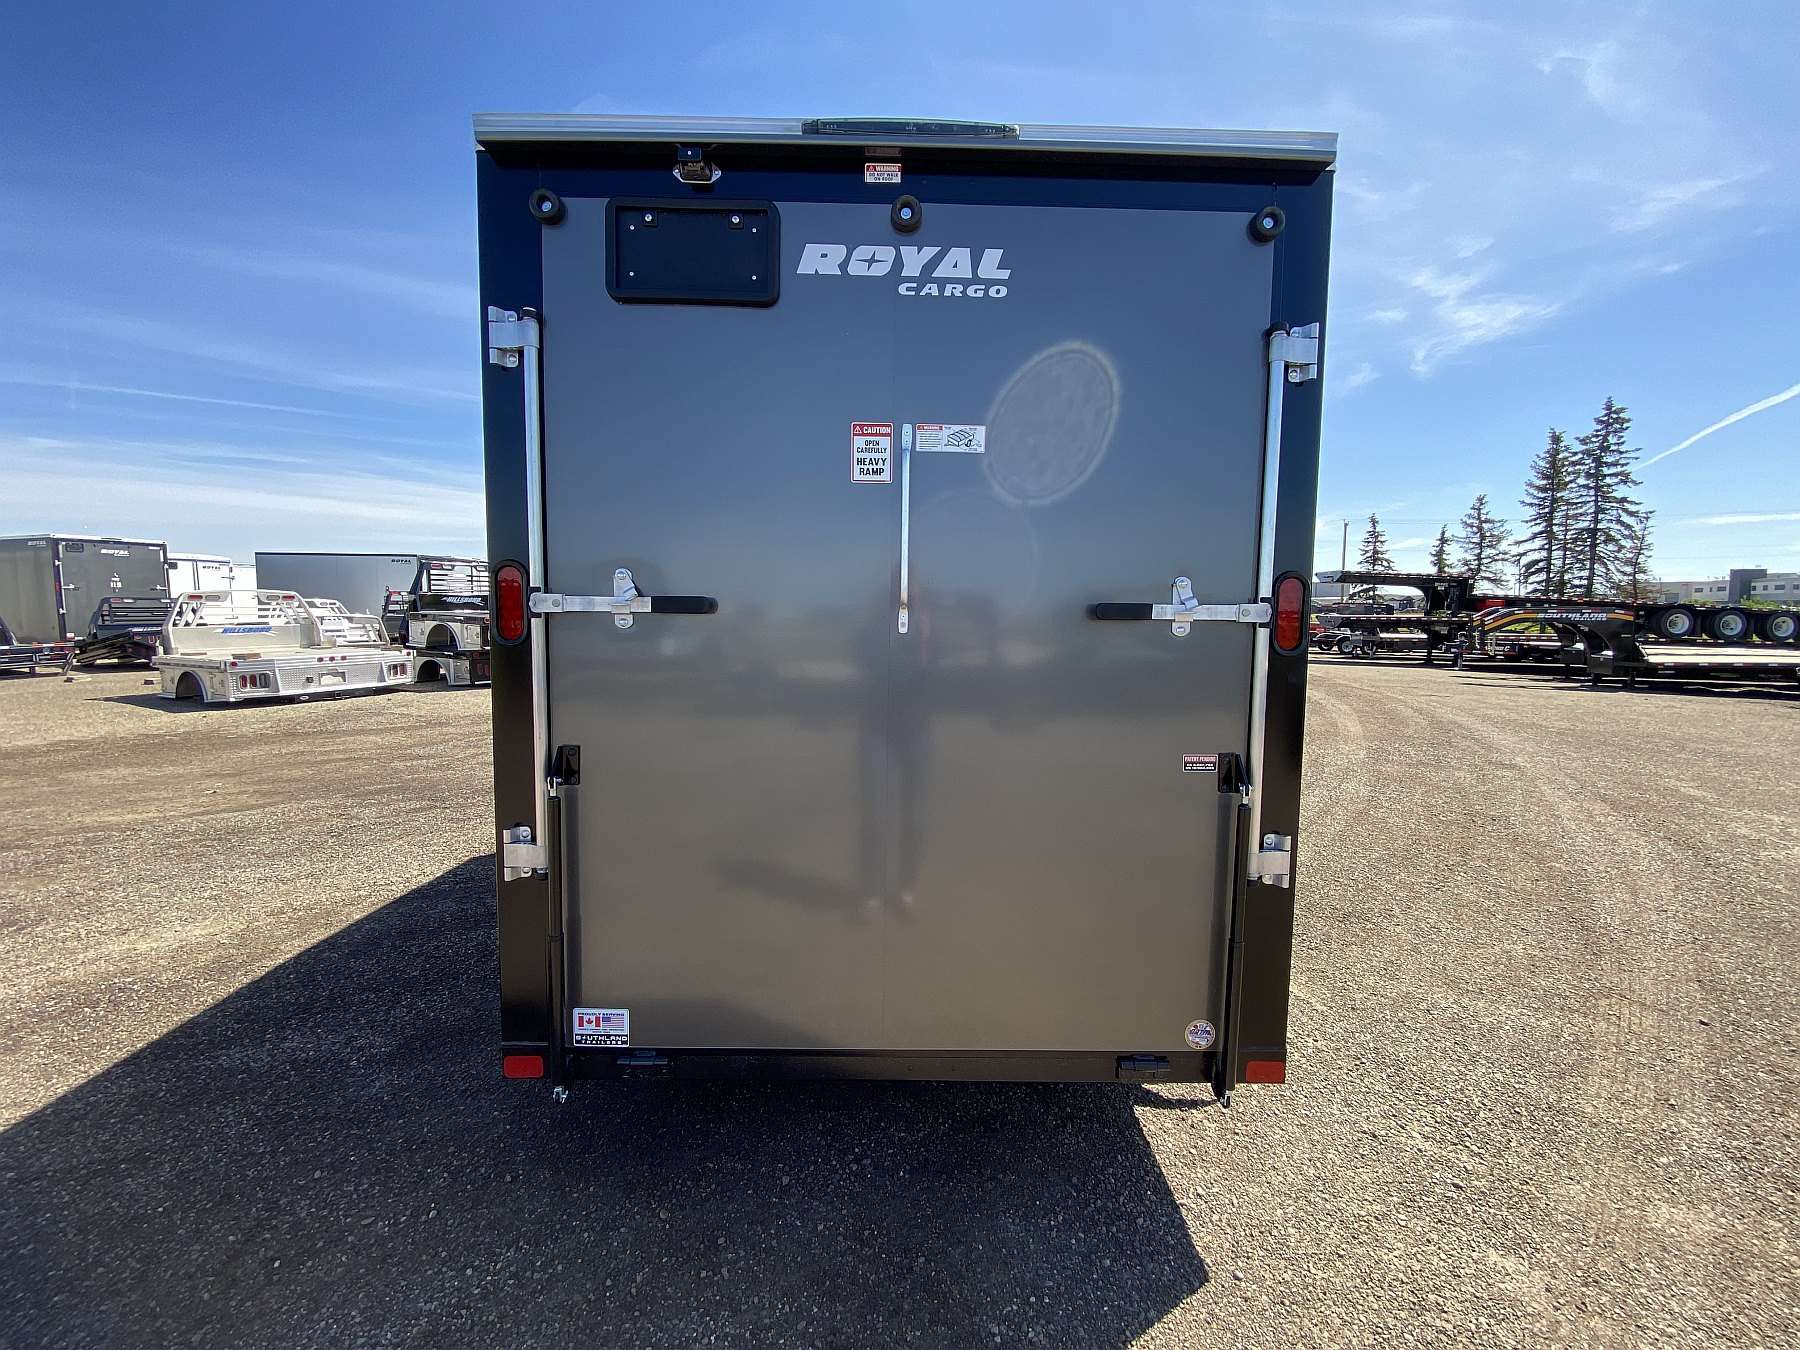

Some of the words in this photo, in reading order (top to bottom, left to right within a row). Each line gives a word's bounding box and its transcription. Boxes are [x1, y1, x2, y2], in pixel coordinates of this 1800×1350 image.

[797, 243, 1011, 280] ROYAL
[898, 282, 1008, 298] CARGO
[857, 458, 887, 466] HEAVY
